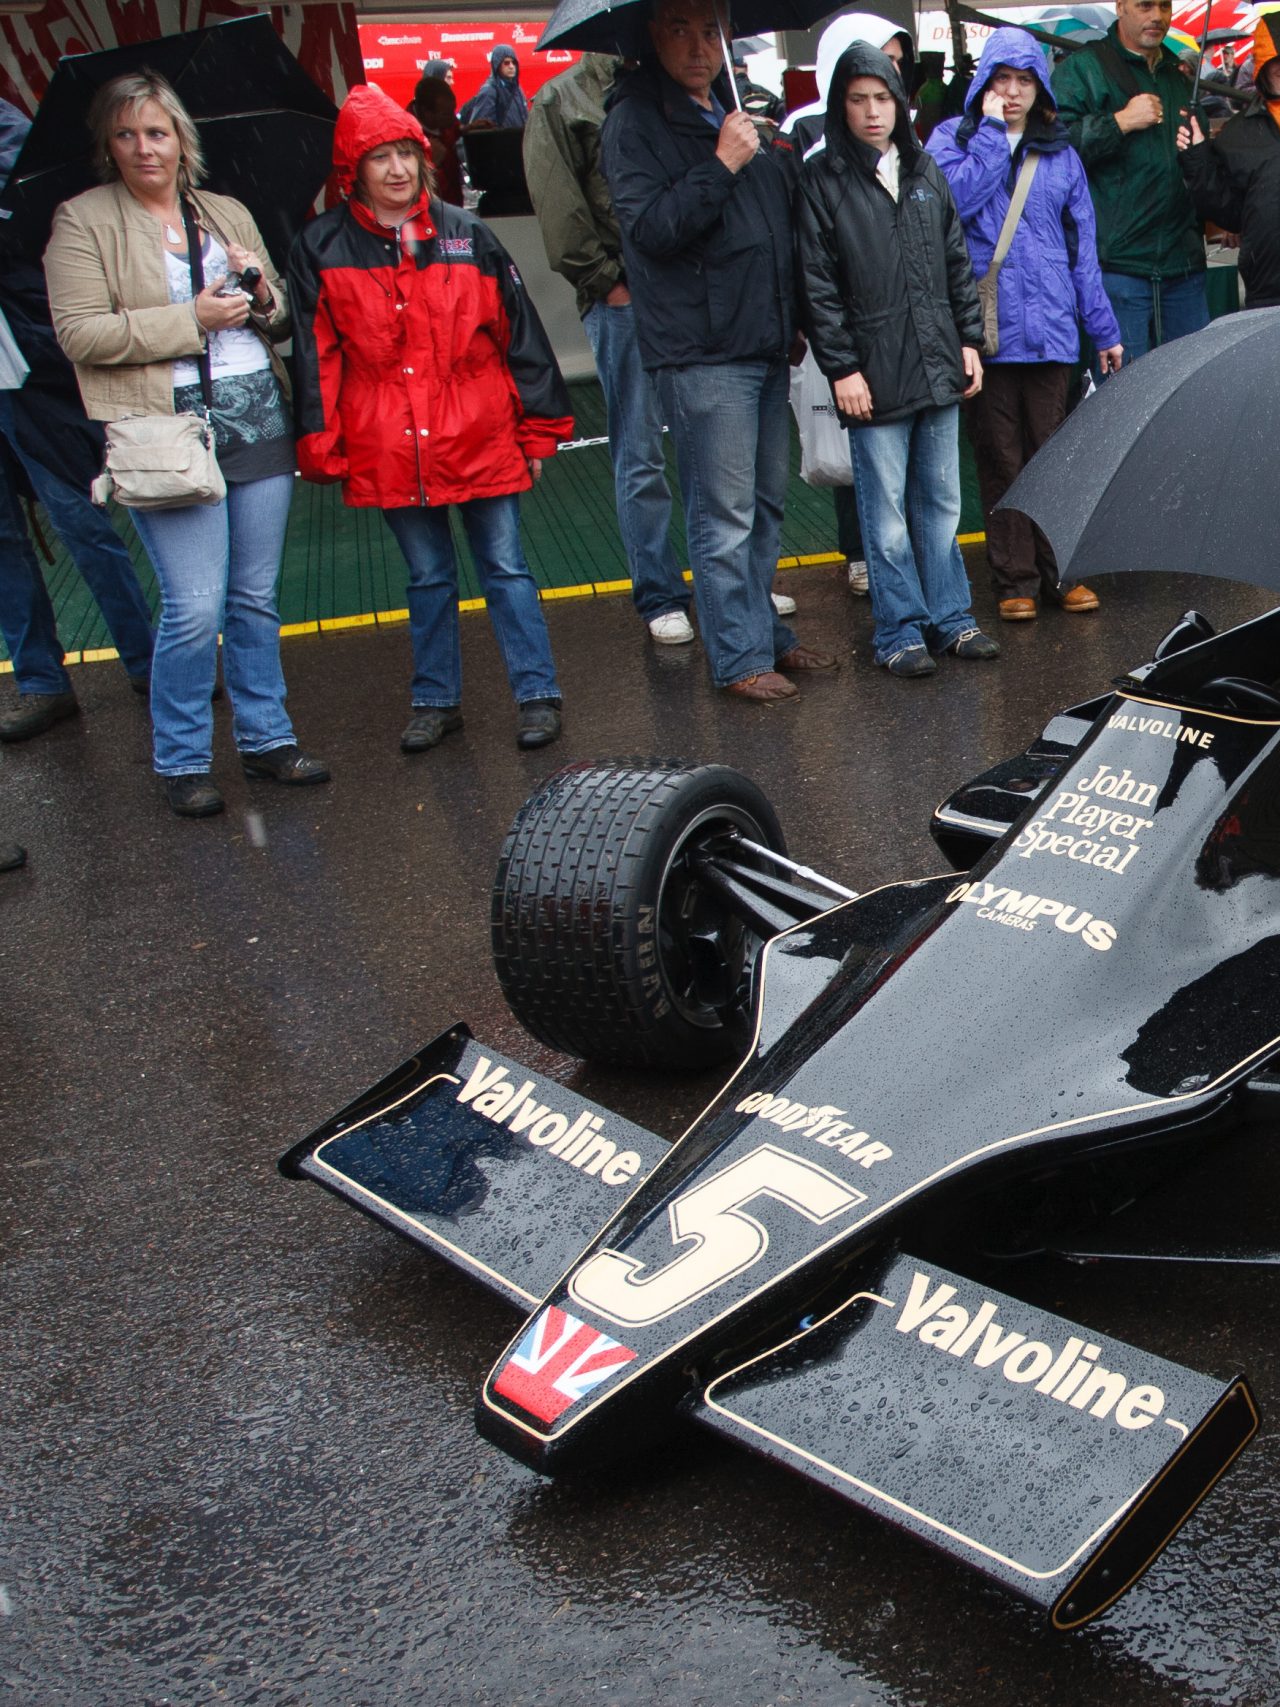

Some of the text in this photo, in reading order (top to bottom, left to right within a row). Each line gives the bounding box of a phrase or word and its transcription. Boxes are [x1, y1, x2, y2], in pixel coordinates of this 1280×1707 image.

[933, 26, 991, 40] DESO
[1108, 715, 1214, 749] VALVOLINE
[1078, 765, 1158, 806] John
[1043, 792, 1153, 840] Player
[1012, 821, 1139, 874] Special
[946, 881, 1117, 951] OLYMPUS
[976, 907, 1038, 931] CAMERAS
[456, 1056, 642, 1185] Valvoline
[735, 1092, 893, 1169] GOODYEAR
[568, 1142, 868, 1328] 5
[895, 1271, 1164, 1430] Valvoline
